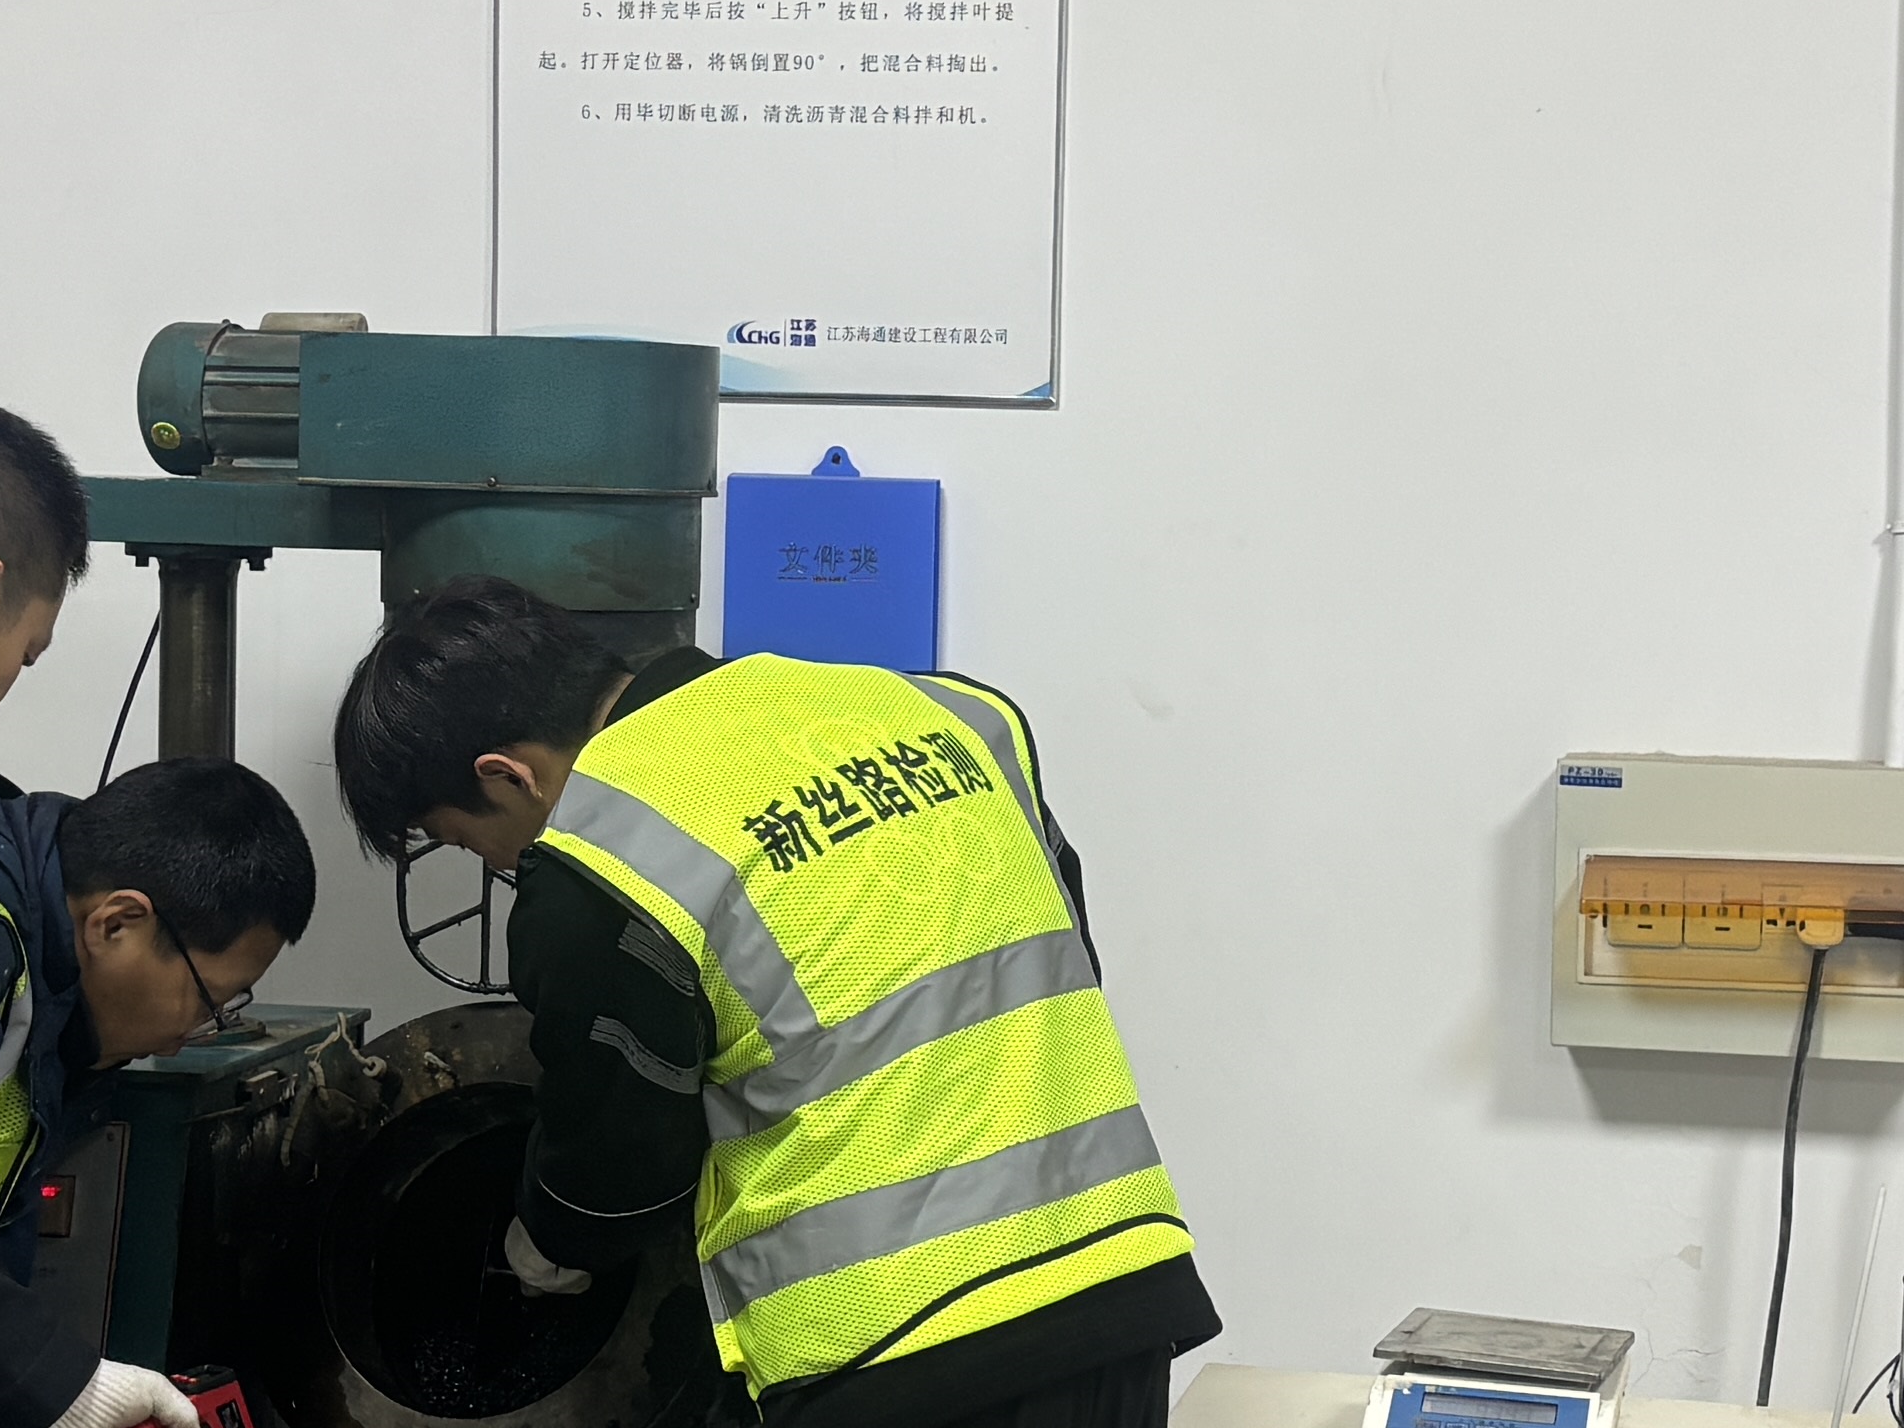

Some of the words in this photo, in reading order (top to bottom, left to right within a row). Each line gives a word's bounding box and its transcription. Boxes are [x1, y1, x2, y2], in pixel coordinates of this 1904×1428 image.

[826, 325, 1009, 345] 江苏海通建设工程有限公司
[741, 728, 995, 873] 新丝路检测
